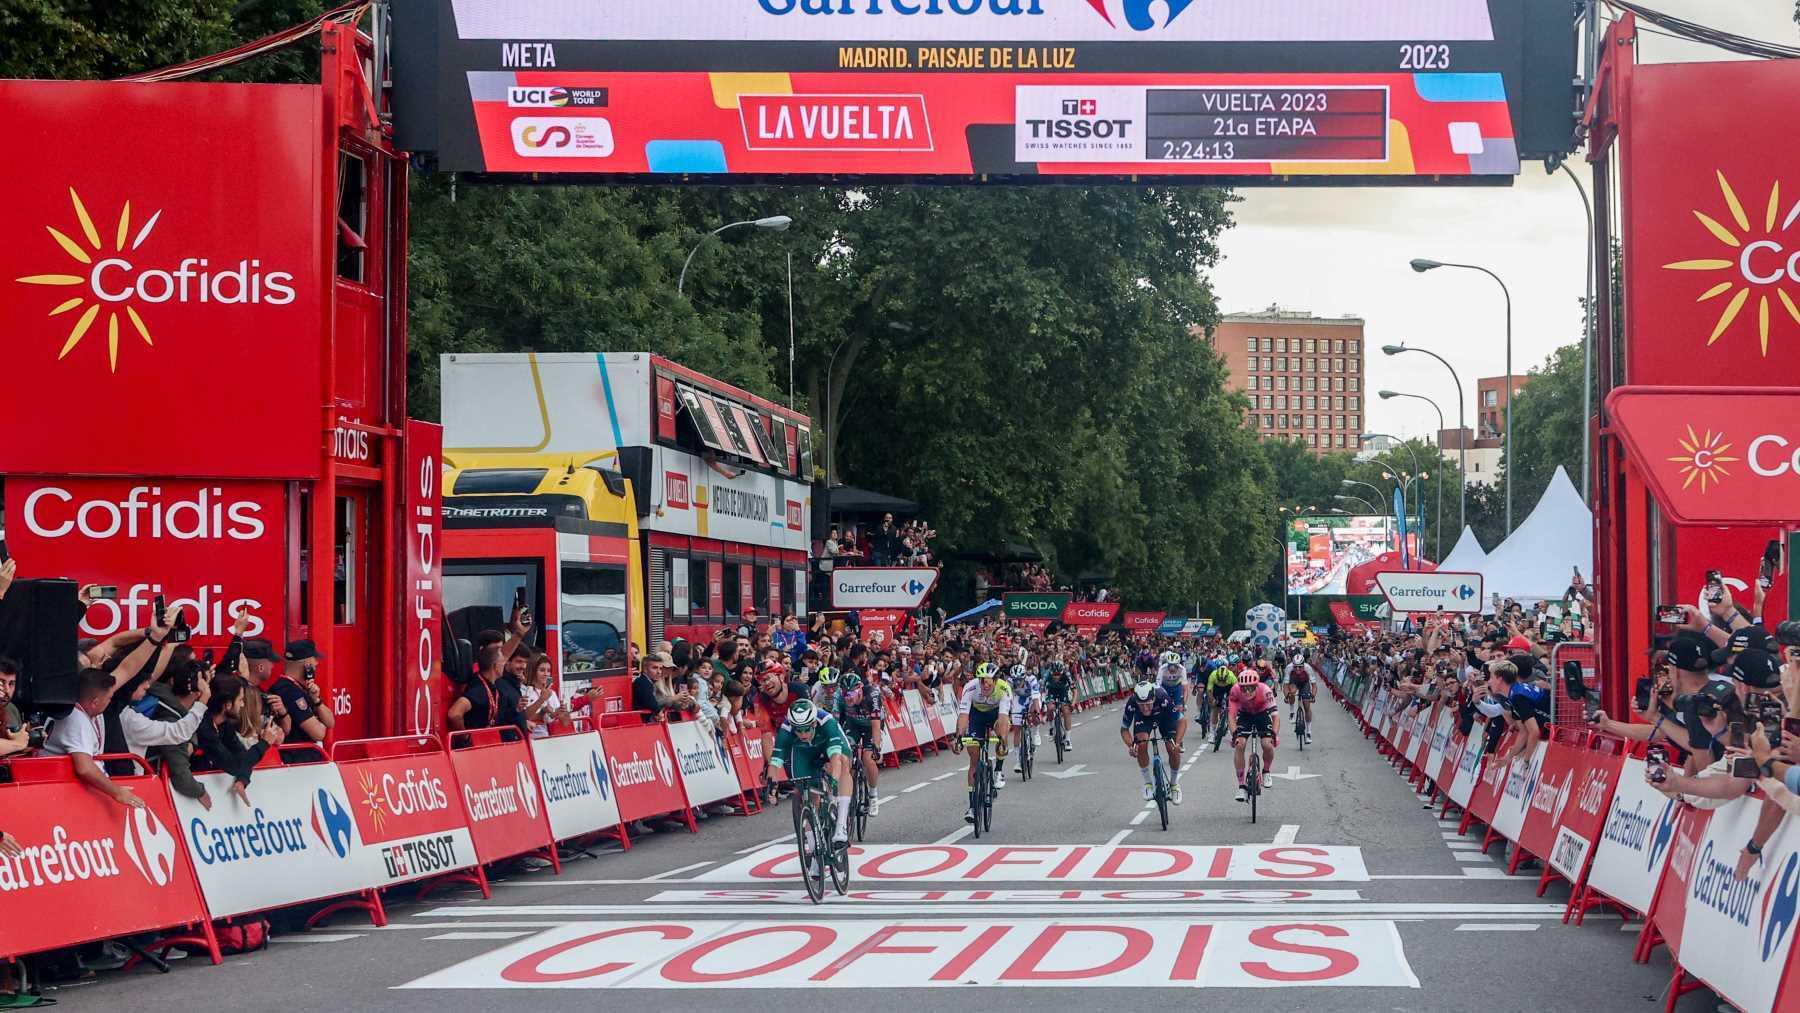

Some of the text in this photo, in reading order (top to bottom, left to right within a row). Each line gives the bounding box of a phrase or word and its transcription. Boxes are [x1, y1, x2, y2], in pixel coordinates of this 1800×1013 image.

[502, 44, 556, 68] META
[839, 47, 1076, 68] MADRID. PAISAJE DE LA LUZ
[1400, 45, 1450, 69] 2023
[513, 90, 546, 103] UCI
[571, 90, 601, 98] WORLD
[573, 97, 595, 105] TOUR
[1202, 93, 1328, 111] VUELTA 2023
[758, 105, 914, 140] LA VUELTA
[1025, 120, 1132, 138] TISSOT
[1256, 117, 1317, 135] ETAPA
[1163, 141, 1235, 159] 2:24:13
[90, 257, 296, 305] Cofidis
[23, 486, 265, 540] Cofidis
[416, 455, 433, 745] Cofidis
[839, 582, 897, 593] Carrefour
[1389, 586, 1447, 597] Carrefour
[1078, 609, 1110, 618] Cofidis
[610, 752, 656, 788] Carrefour
[677, 742, 716, 776] Carrefour
[383, 768, 448, 816] Cofidis
[464, 776, 518, 822] Carrefour
[541, 763, 590, 803] Carrefour
[191, 807, 307, 865] Carrefour
[1604, 795, 1652, 852] Carrefour
[402, 835, 457, 874] TISSOT
[749, 845, 1336, 879] COFIDIS
[500, 923, 1360, 983] COFIDIS
